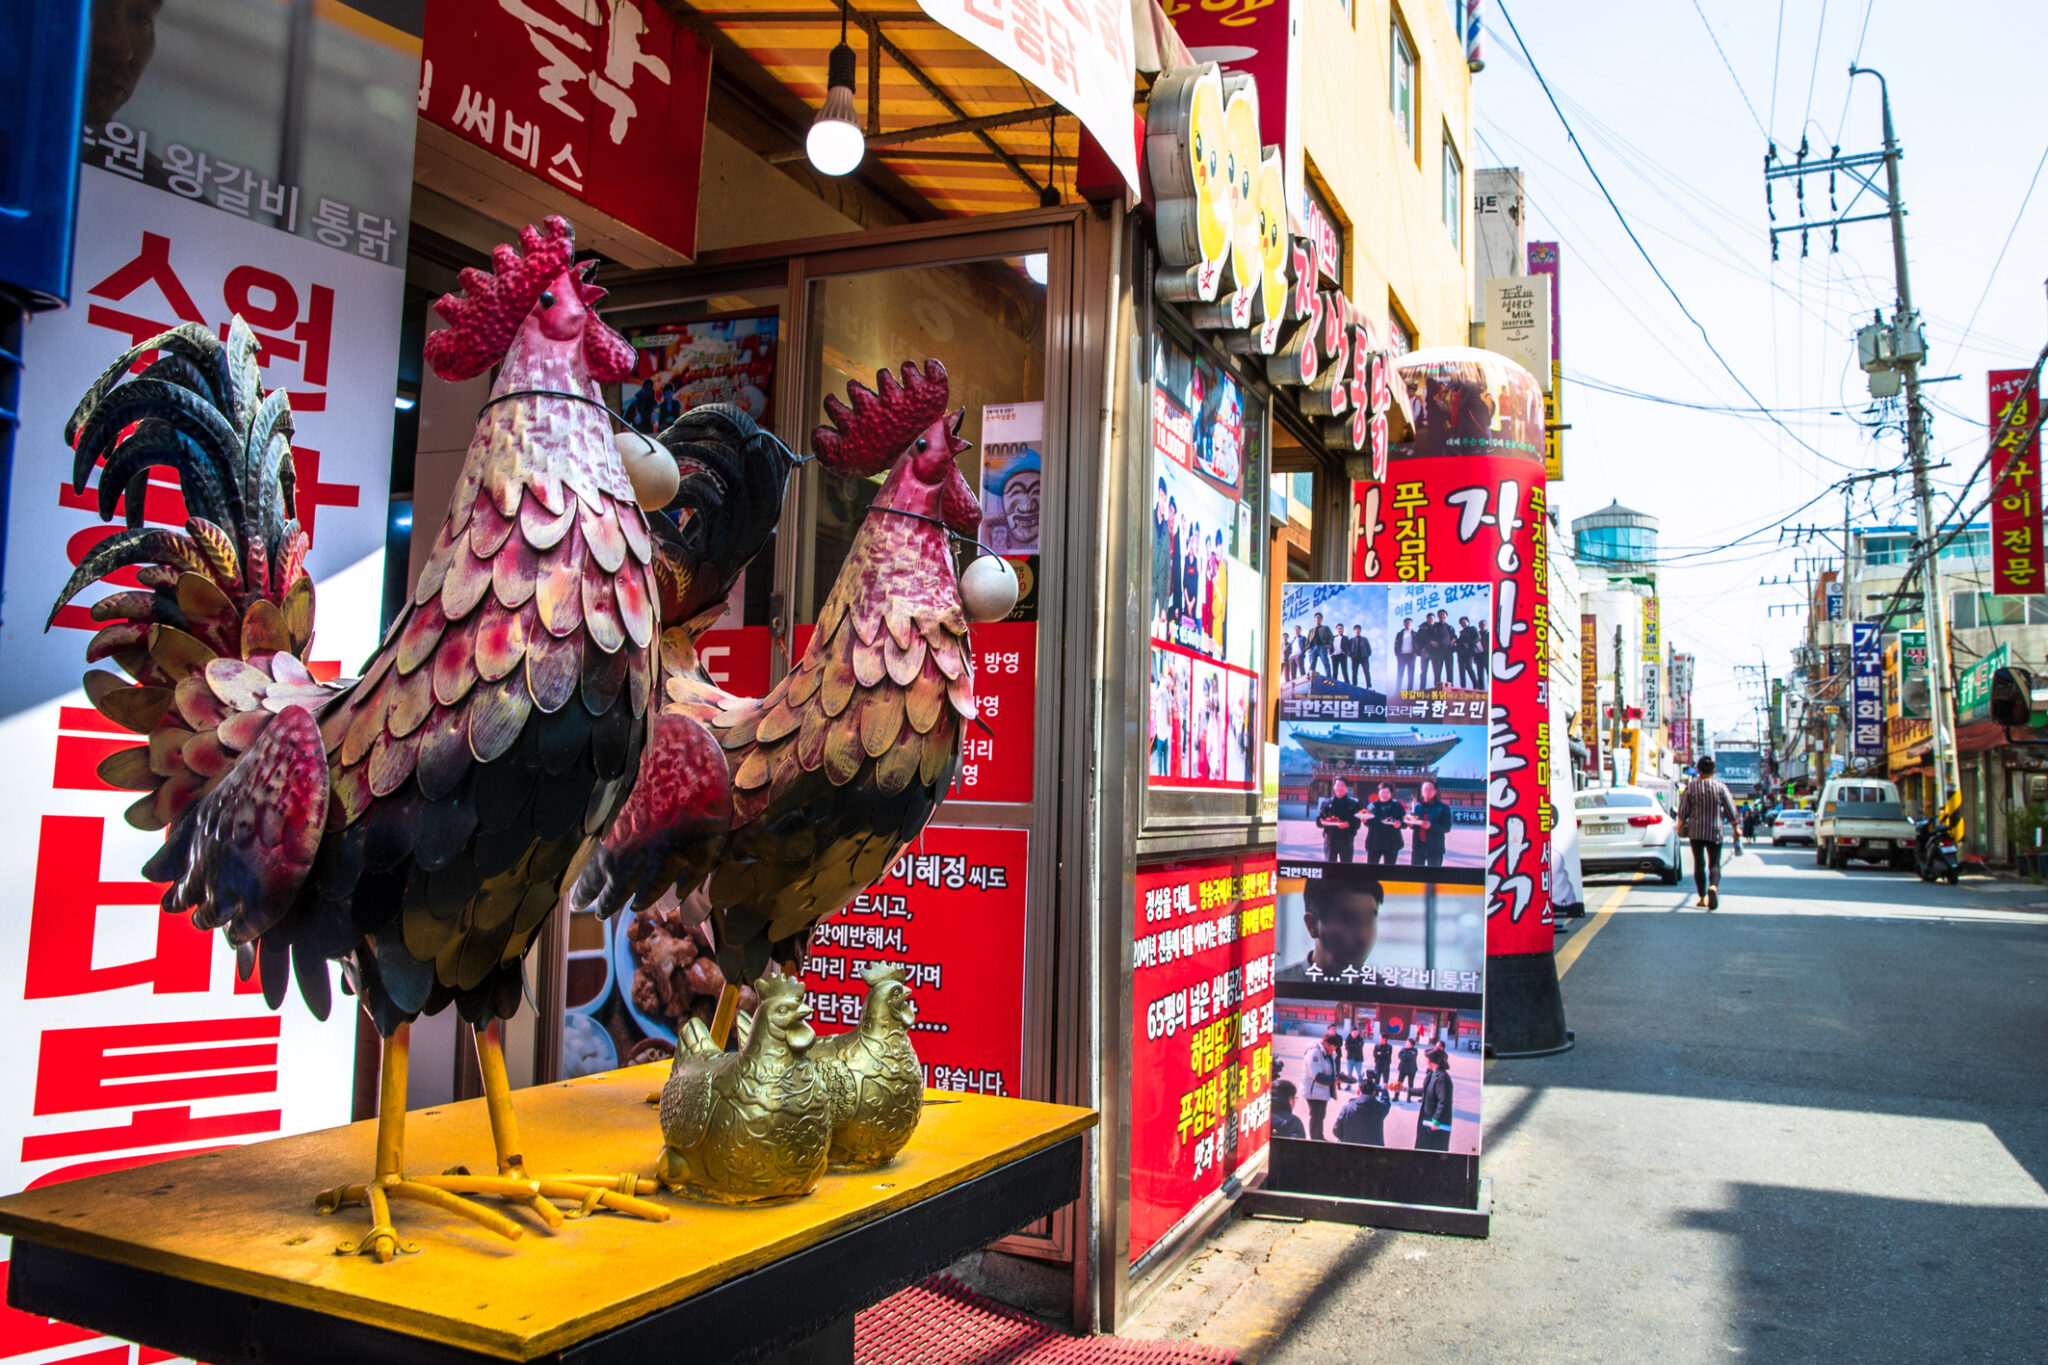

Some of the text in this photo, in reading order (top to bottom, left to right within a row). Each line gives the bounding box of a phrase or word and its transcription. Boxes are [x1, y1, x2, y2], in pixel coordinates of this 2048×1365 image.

[452, 84, 583, 192] 써비스
[162, 143, 298, 232] 왕갈비
[312, 197, 397, 262] 통닭
[1512, 310, 1532, 319] Milk
[1292, 240, 1391, 484] 장안통닭
[985, 442, 1028, 459] 10000
[2002, 526, 2036, 585] 전문
[1394, 602, 1414, 618] 이런
[1416, 594, 1441, 613] 맛은
[985, 652, 1019, 674] 방영
[1529, 486, 1548, 596] 푸짐한
[1540, 840, 1553, 925] 서비스
[1855, 628, 1882, 745] 가구백화점
[1283, 699, 1360, 719] 극한직업
[891, 854, 1008, 890] 이혜정 씨도
[852, 894, 913, 920] 드시고,
[1145, 885, 1172, 923] 정성을
[1381, 965, 1436, 989] 왕갈비
[1441, 969, 1479, 992] 통닭
[1147, 986, 1187, 1040] 65평의
[1190, 980, 1210, 1026] 넓은
[934, 1065, 1008, 1097] 않습니다.
[1177, 1076, 1218, 1144] 푸짐한
[1193, 1131, 1214, 1182] 맛과
